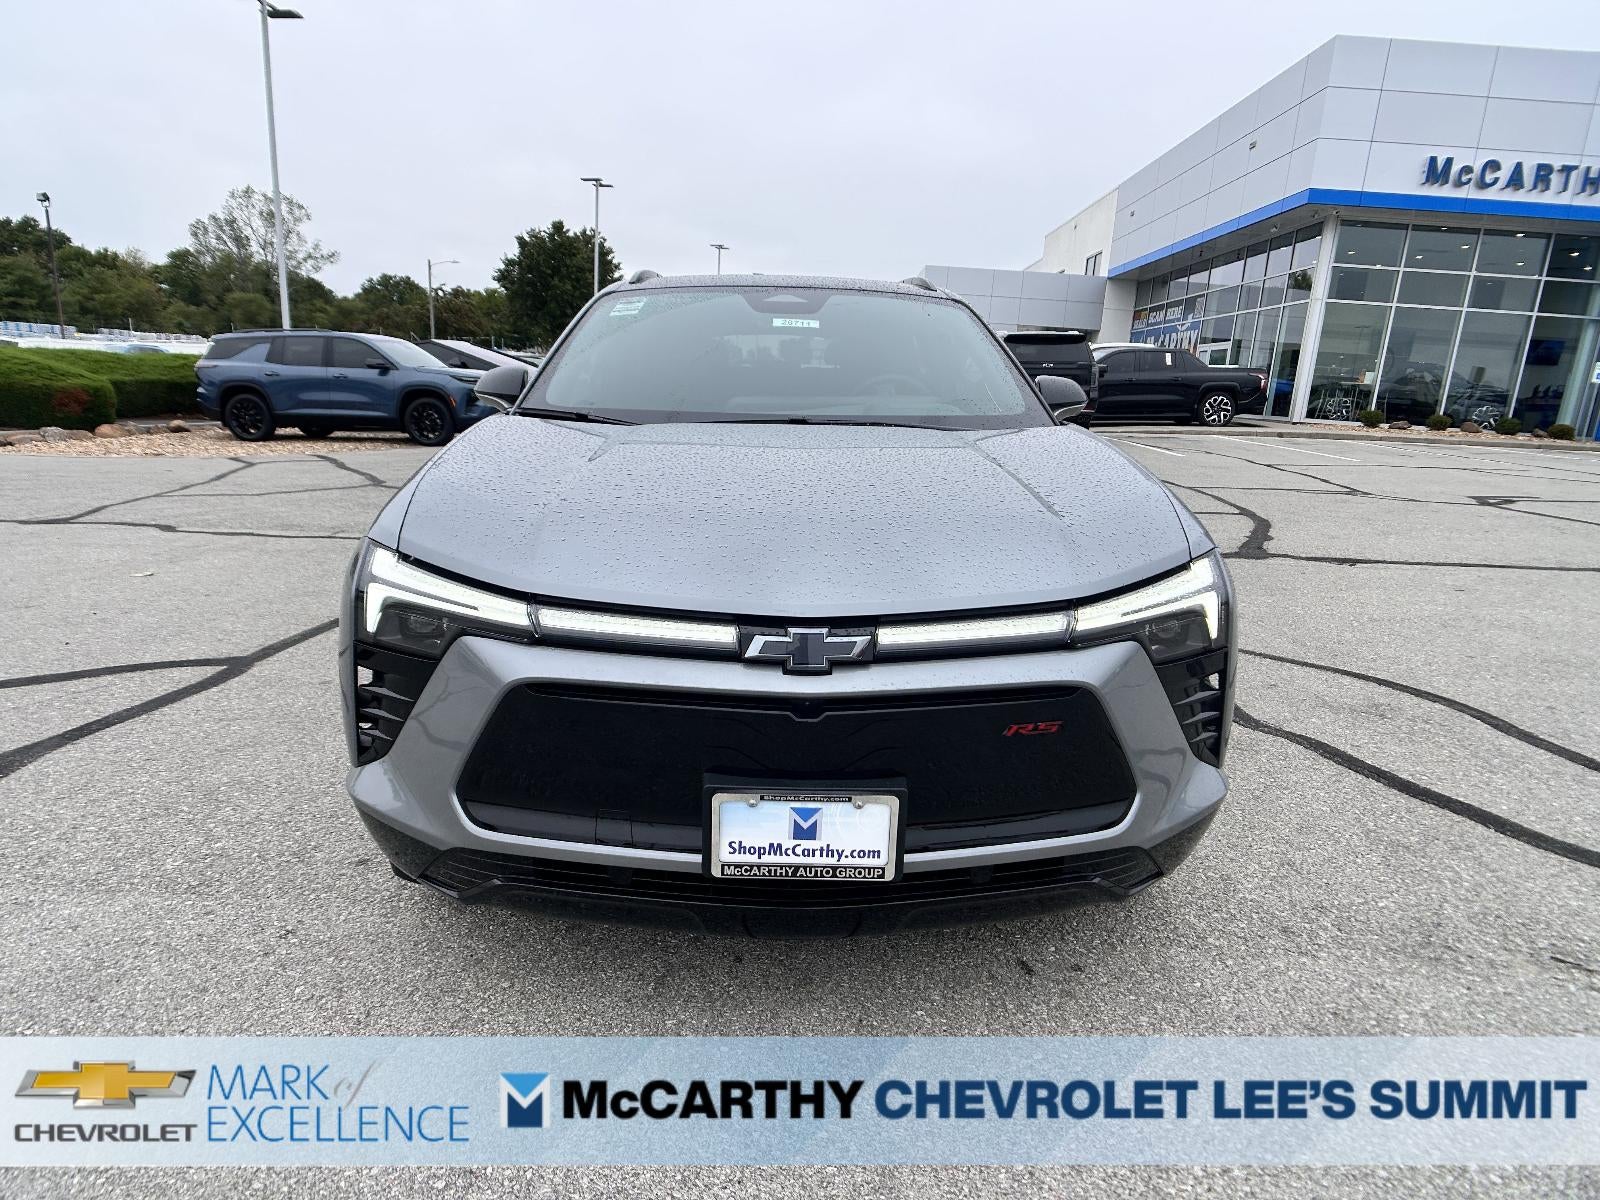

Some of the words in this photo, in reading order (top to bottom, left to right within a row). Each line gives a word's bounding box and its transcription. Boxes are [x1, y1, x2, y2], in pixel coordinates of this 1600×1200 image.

[1424, 155, 1600, 196] McCARTH
[1002, 721, 1064, 737] RS
[728, 841, 881, 862] ShopMcCarthy.com
[724, 866, 795, 877] McCARTHY
[797, 867, 834, 877] AUTO
[836, 867, 883, 878] GROUP
